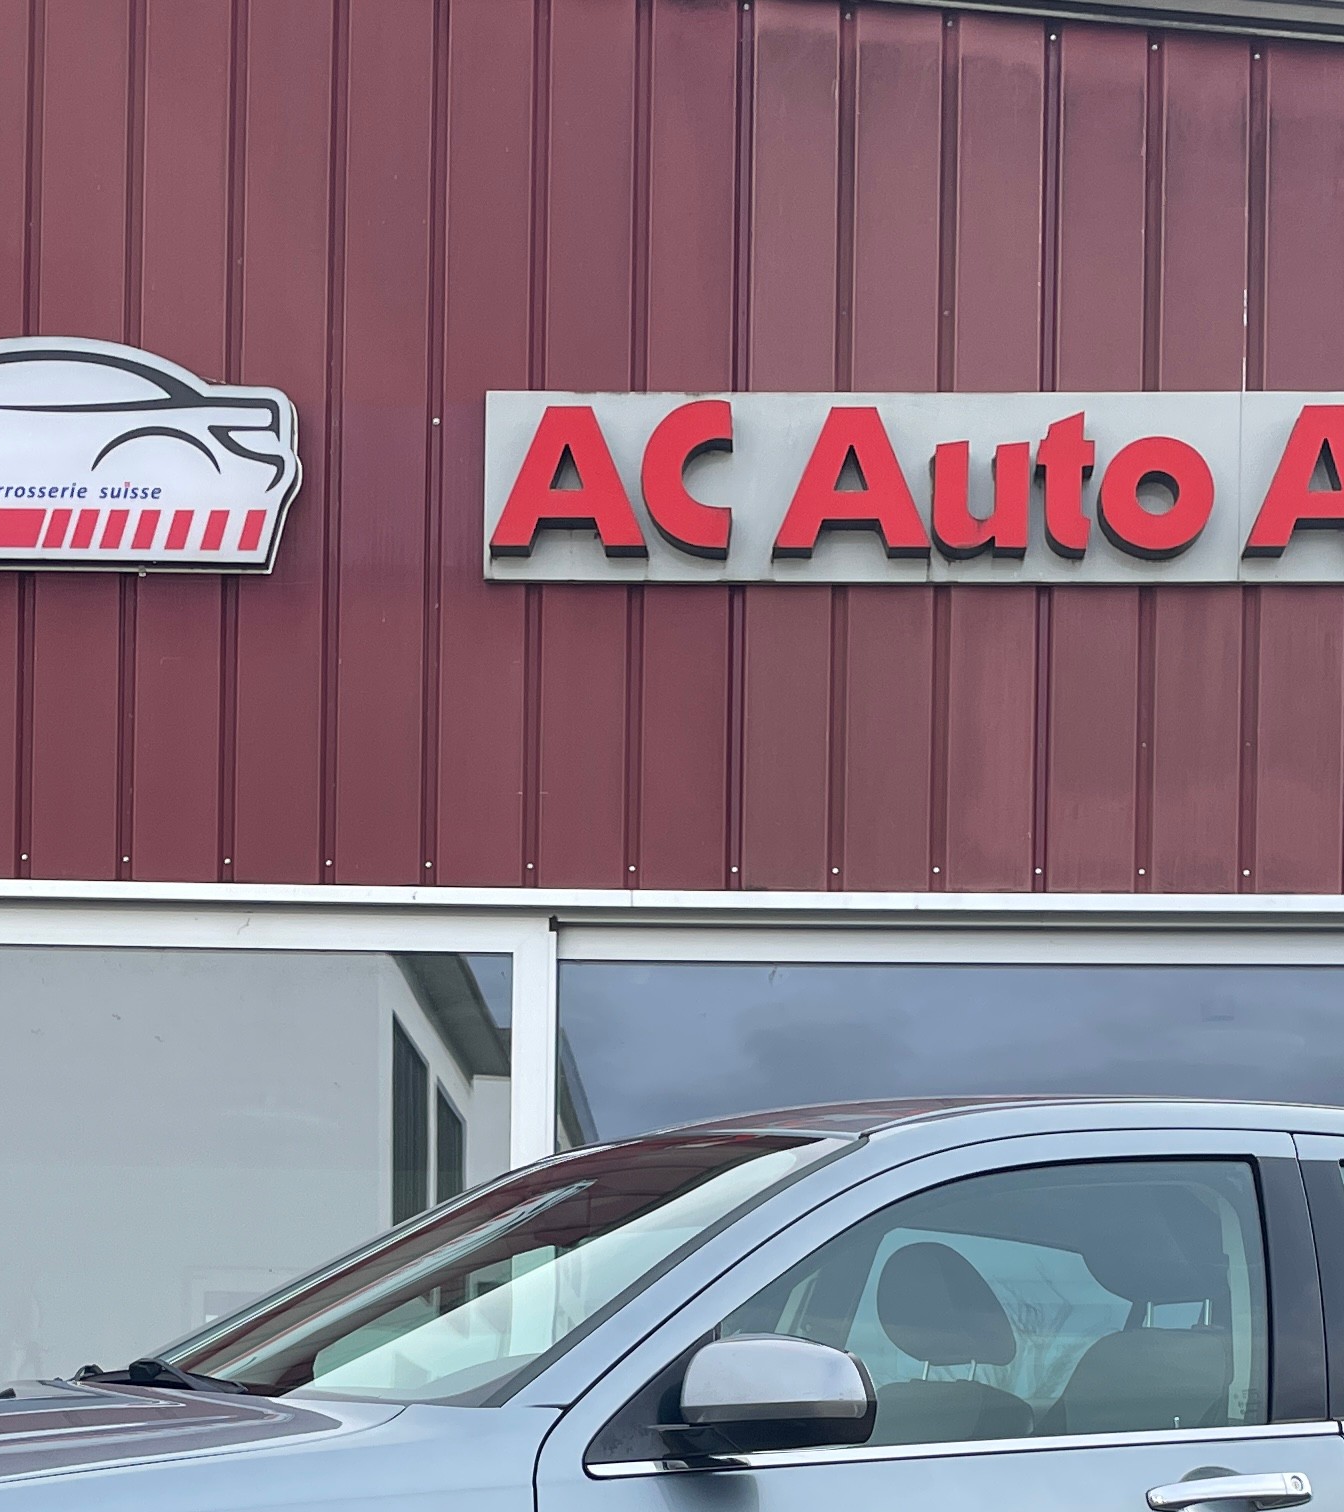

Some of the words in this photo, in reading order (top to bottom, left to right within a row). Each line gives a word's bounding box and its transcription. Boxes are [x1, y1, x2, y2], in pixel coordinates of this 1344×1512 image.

[99, 481, 162, 500] suisse
[489, 400, 735, 561] AC
[771, 406, 1217, 561] Auto
